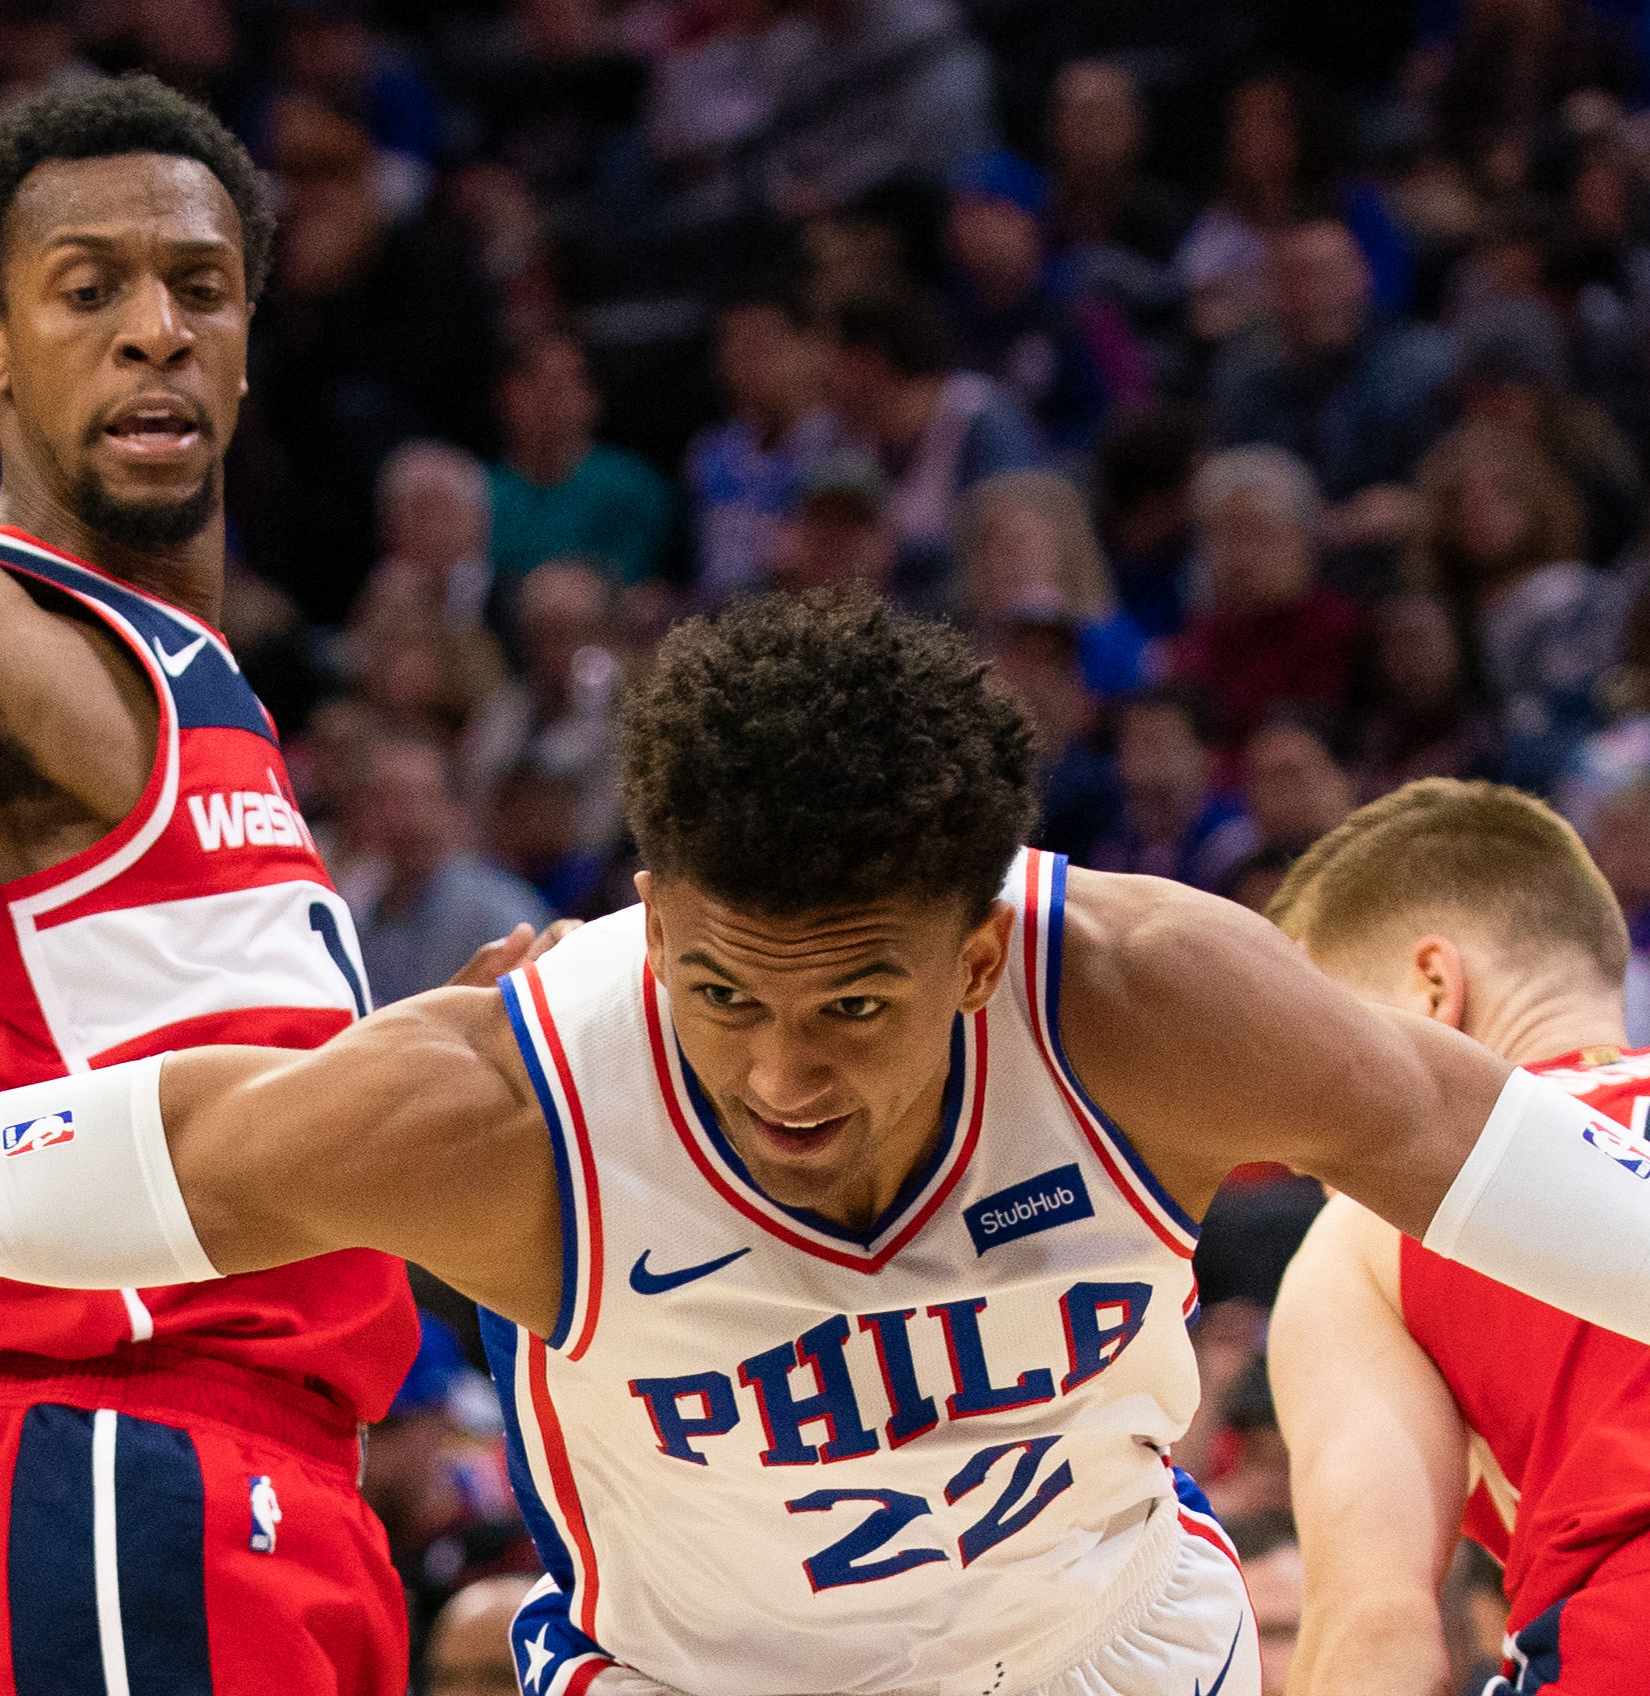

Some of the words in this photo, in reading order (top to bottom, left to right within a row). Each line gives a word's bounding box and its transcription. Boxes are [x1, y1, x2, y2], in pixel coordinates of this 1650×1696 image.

[980, 1185, 1075, 1236] StubHub
[629, 1282, 1153, 1466] PHILA
[785, 1434, 1074, 1595] 22
